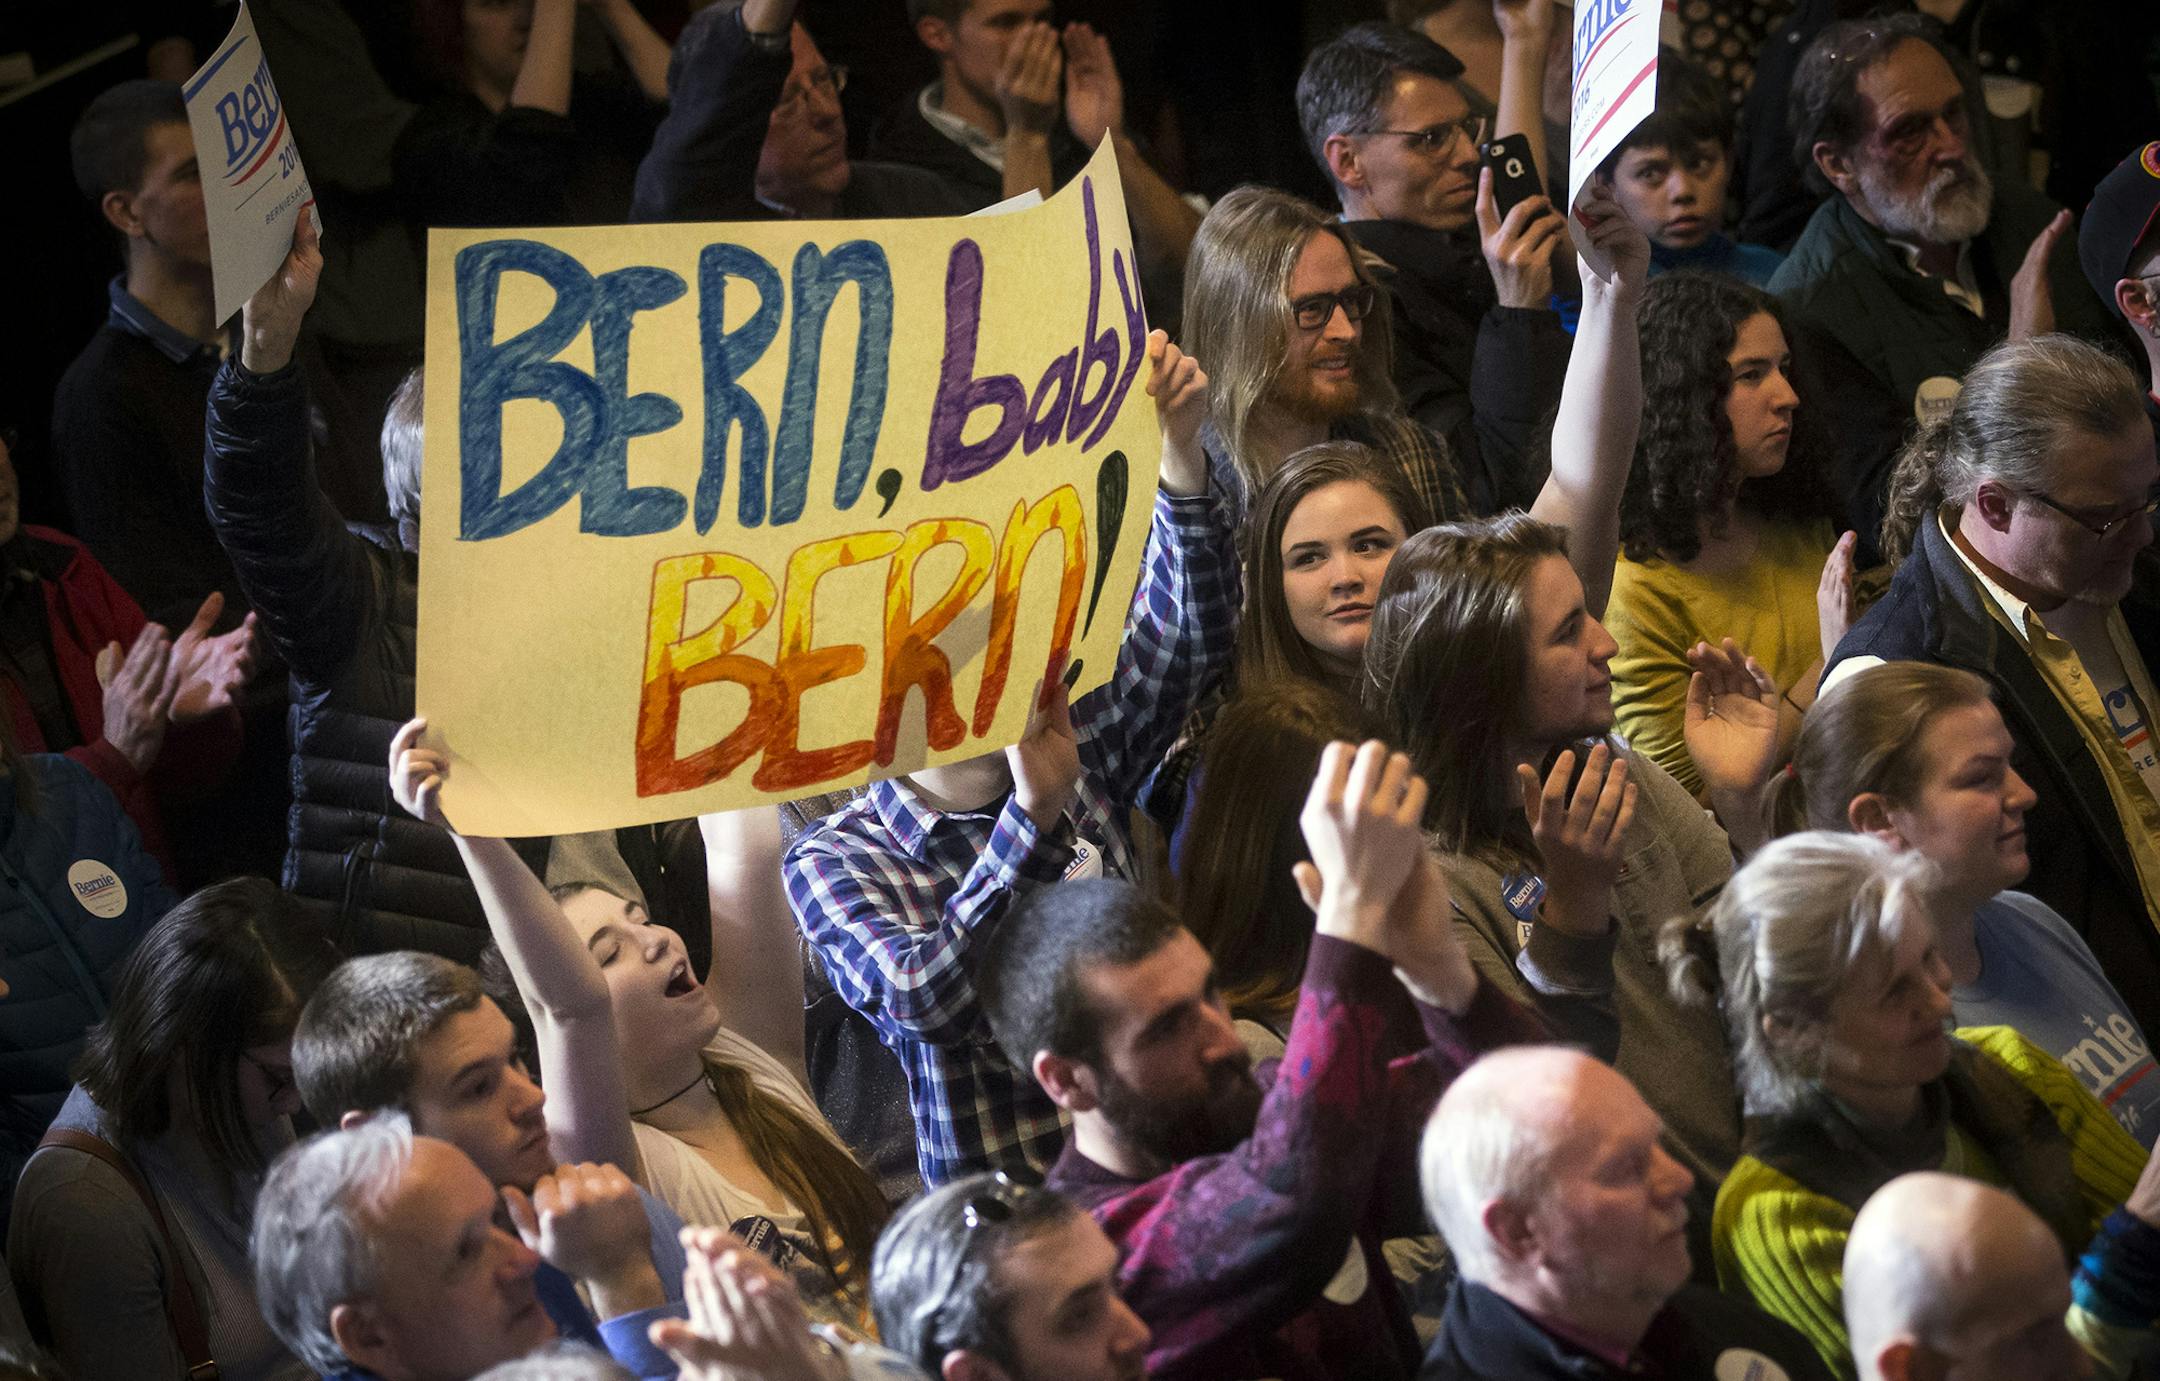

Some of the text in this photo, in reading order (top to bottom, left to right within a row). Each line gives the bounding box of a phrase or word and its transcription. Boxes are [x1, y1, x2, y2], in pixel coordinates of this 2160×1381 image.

[455, 174, 1147, 541] BERN, baby
[635, 450, 1130, 798] BERN!
[74, 874, 116, 895] Bernie
[1508, 878, 1538, 909] Bernie
[748, 1220, 771, 1250] ernie
